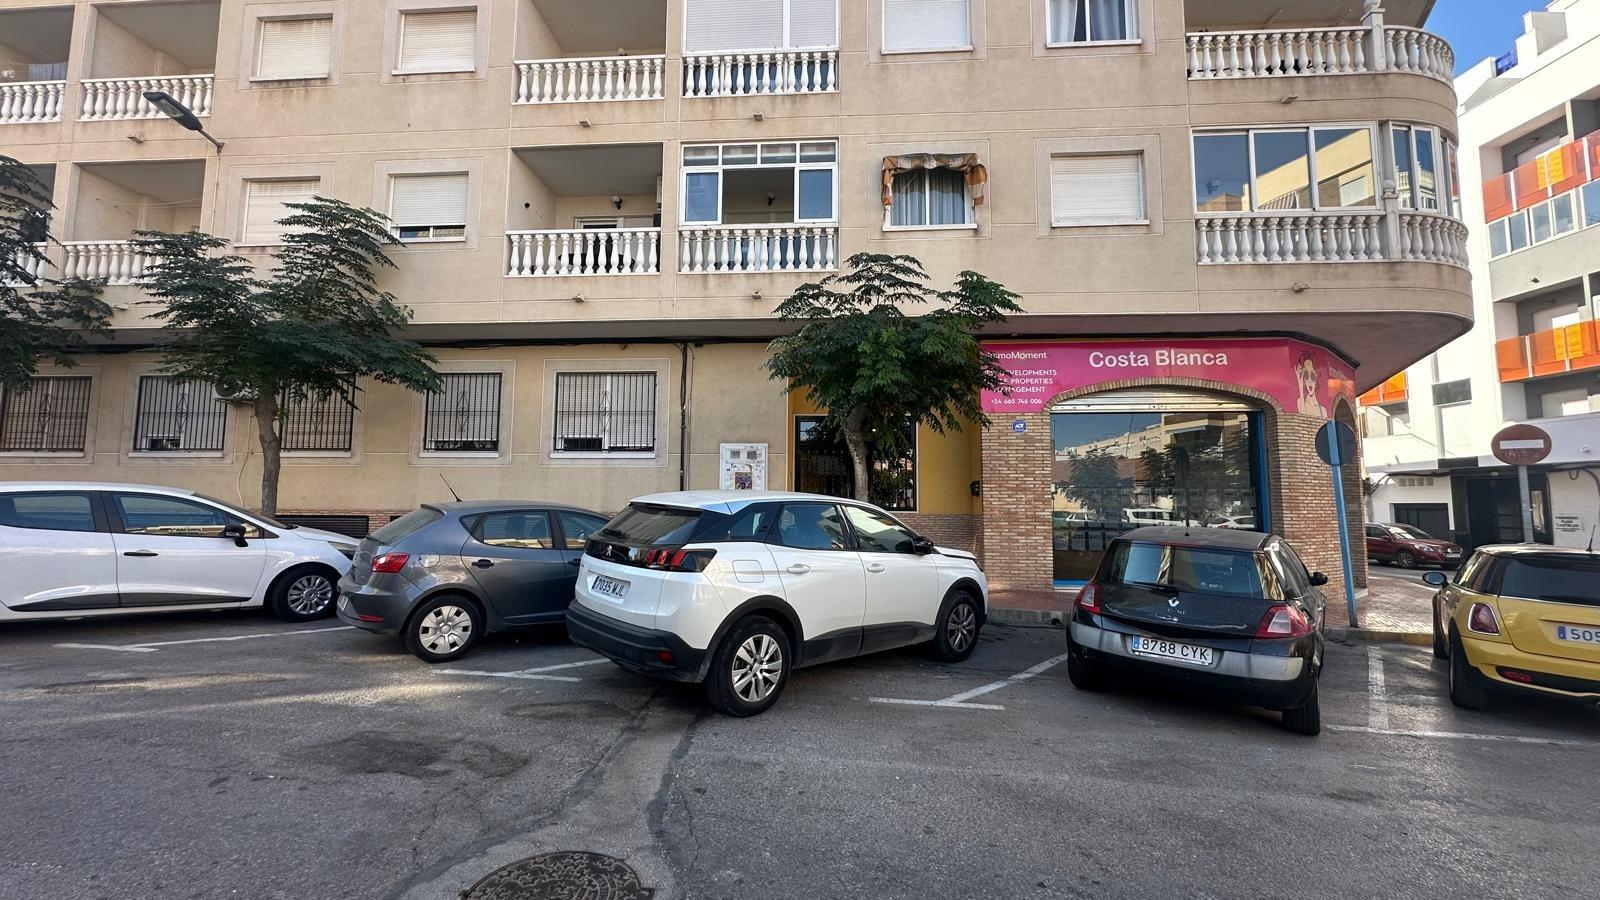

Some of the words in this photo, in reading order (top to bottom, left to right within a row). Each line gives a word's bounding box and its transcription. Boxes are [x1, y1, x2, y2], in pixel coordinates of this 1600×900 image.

[1089, 351, 1149, 367] Costa
[1155, 349, 1228, 366] Blanca
[595, 579, 612, 592] 7035
[1142, 639, 1175, 654] 8788
[1181, 645, 1208, 660] CYK
